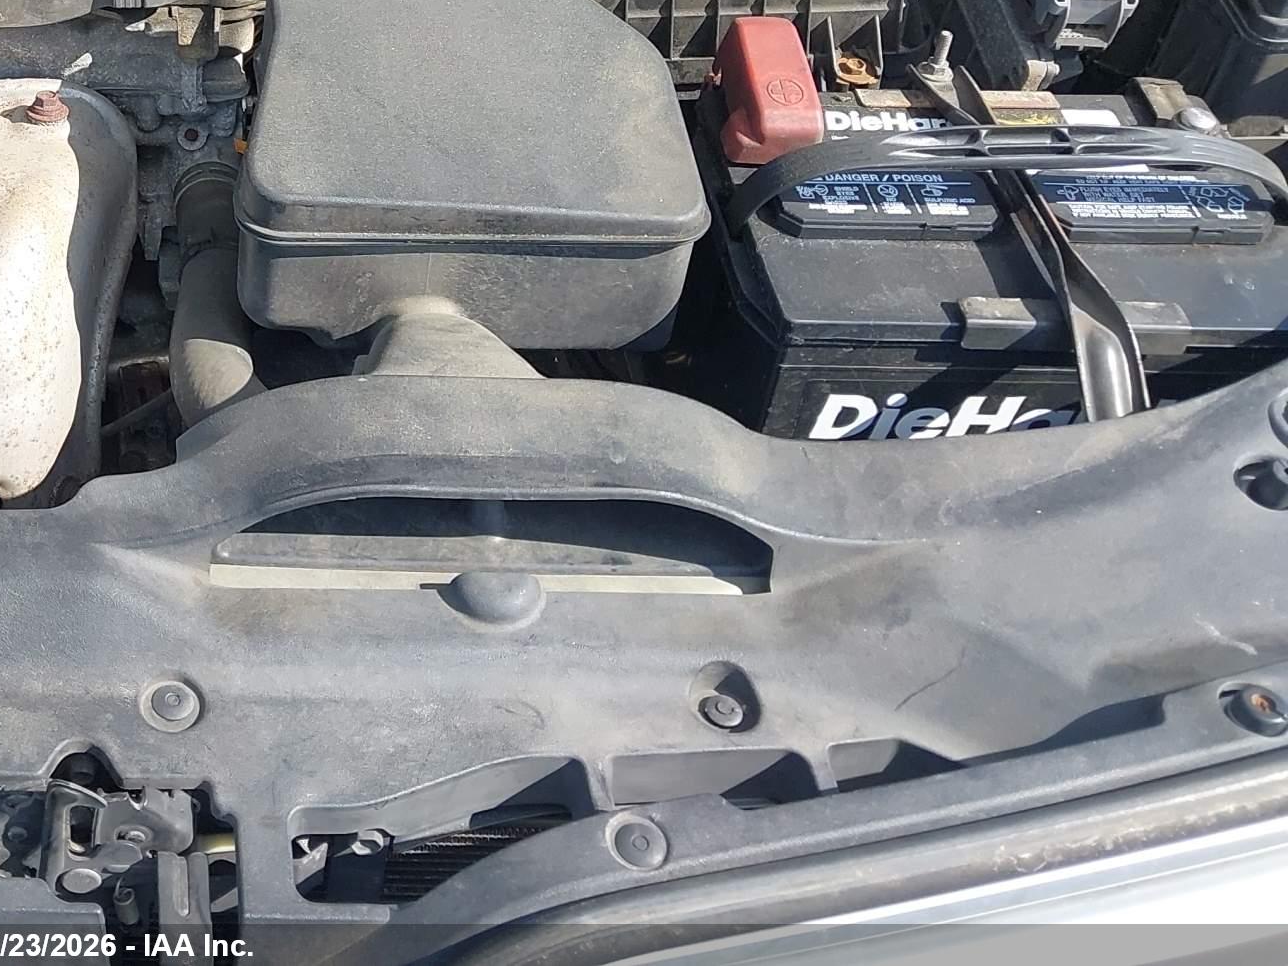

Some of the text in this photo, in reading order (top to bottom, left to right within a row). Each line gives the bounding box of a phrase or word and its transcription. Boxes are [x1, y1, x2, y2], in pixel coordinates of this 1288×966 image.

[825, 110, 949, 132] DieHar
[892, 174, 944, 183] POISON
[808, 392, 1076, 440] DieHa
